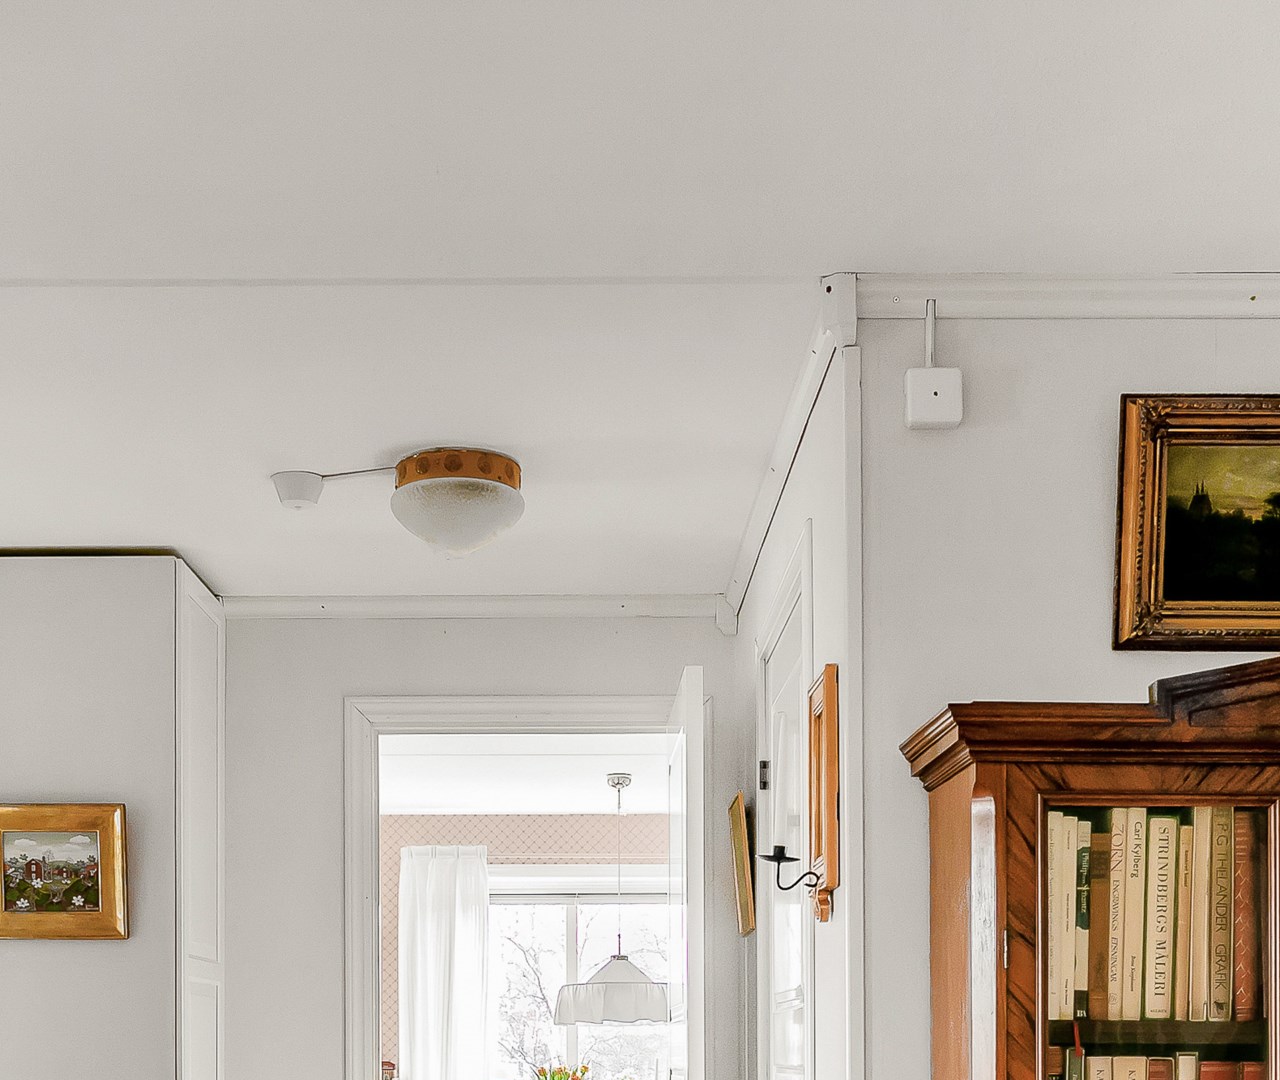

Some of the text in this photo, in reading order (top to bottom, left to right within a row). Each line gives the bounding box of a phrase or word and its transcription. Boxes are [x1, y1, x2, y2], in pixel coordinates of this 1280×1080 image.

[1110, 823, 1124, 983] ZORN ENGRAVINGS ETSNINGAR
[1130, 821, 1143, 879] Carl Kylberg
[1154, 826, 1171, 934] STRINDBERGS
[1215, 823, 1228, 991] P G THELANDER GRAFIK
[1153, 939, 1172, 998] MÅLERI
